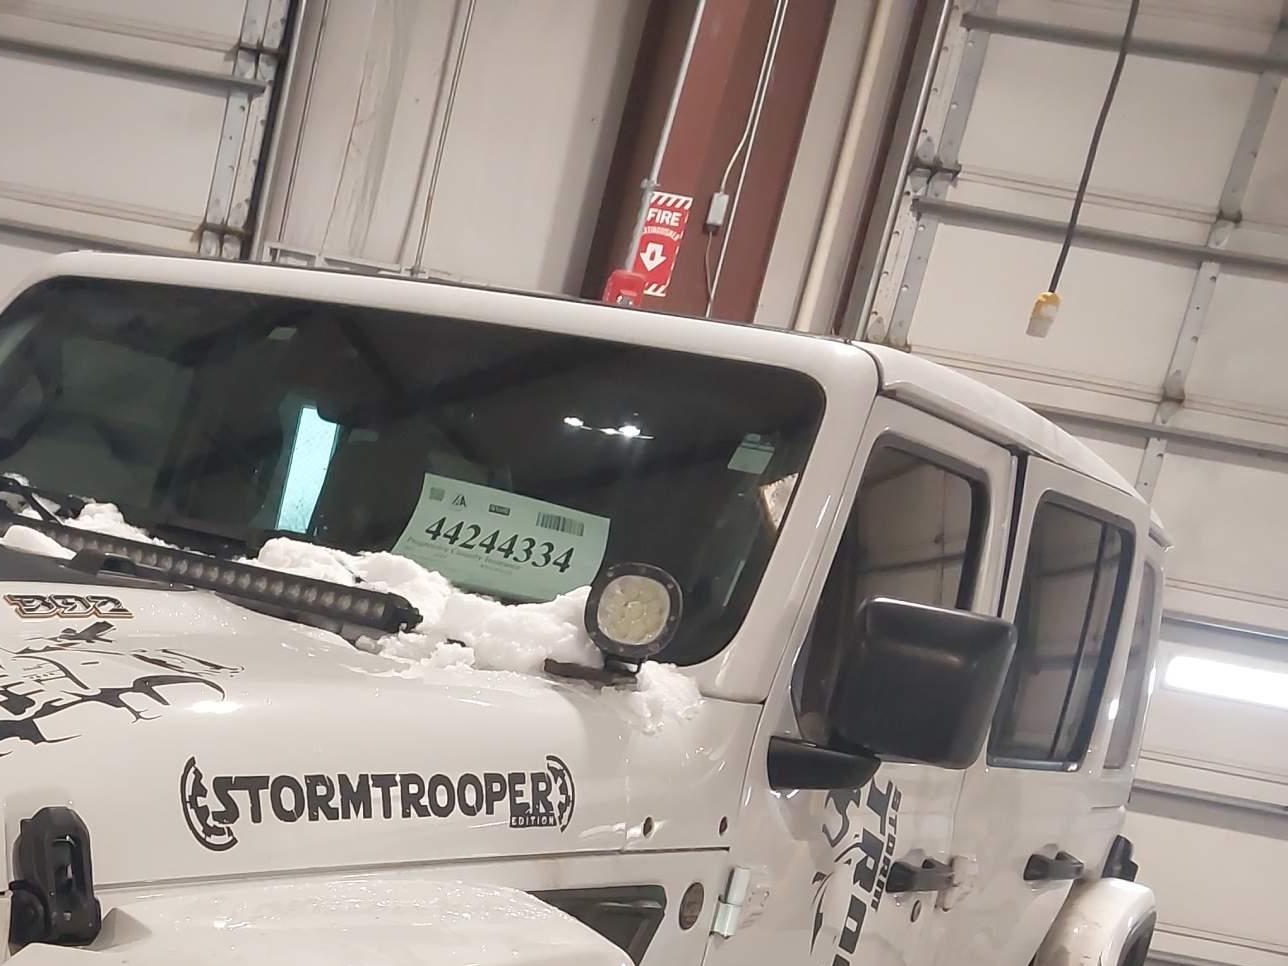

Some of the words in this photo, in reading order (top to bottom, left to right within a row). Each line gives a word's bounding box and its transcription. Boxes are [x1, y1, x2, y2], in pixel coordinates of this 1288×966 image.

[647, 208, 682, 227] FIRE
[425, 517, 574, 573] 44244334
[3, 594, 134, 618] 392
[211, 772, 556, 825] STORMTROOPER
[511, 816, 555, 826] EDITION
[870, 786, 902, 912] STORM
